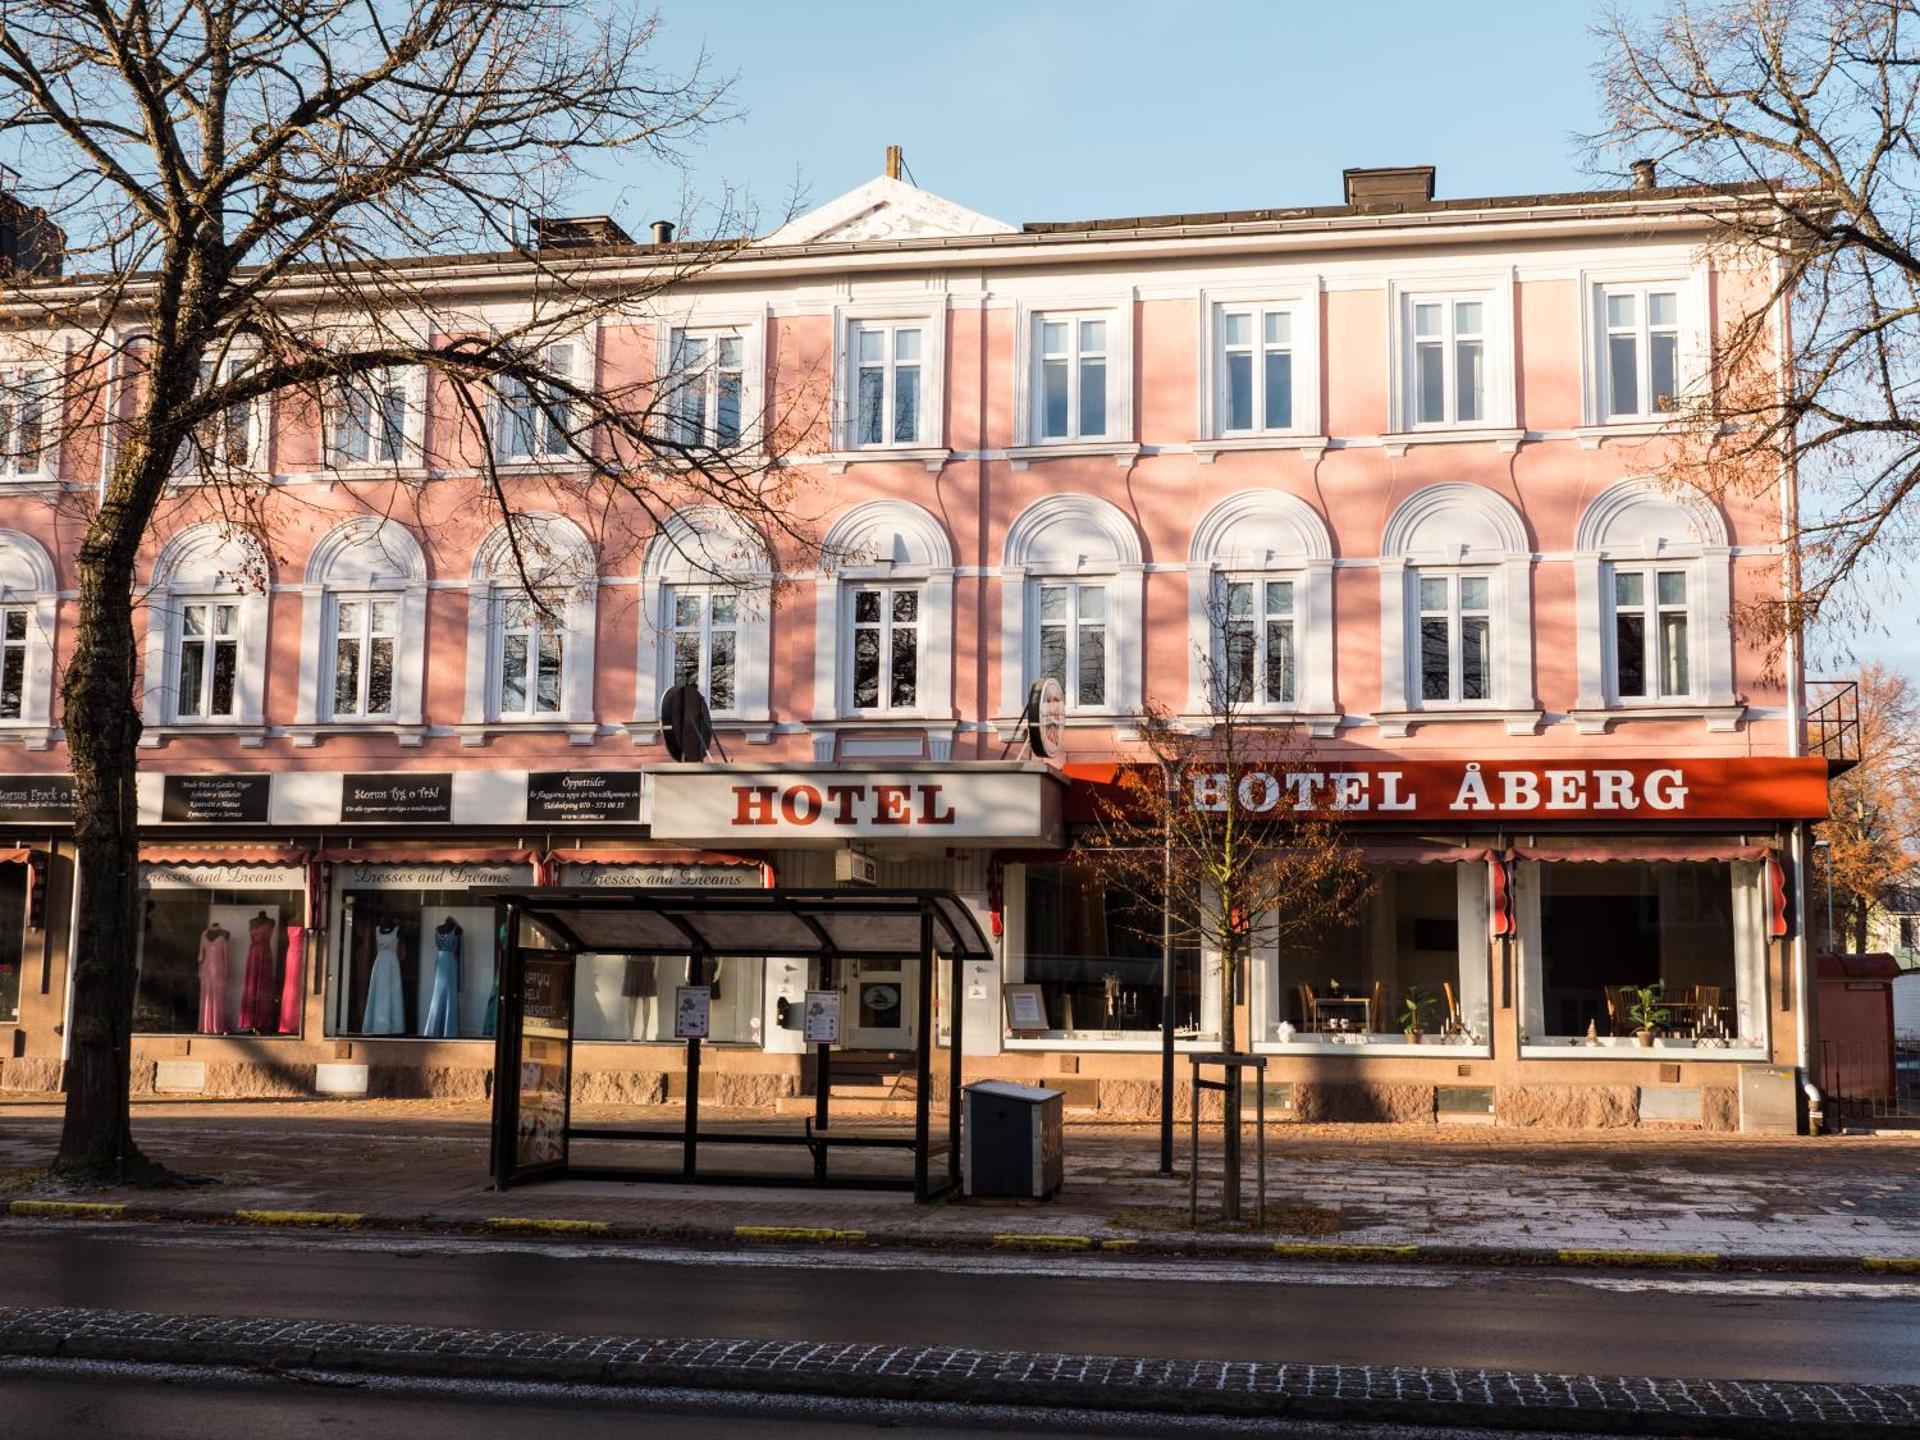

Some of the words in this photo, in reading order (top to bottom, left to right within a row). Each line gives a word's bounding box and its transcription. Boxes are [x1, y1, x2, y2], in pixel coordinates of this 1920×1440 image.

[562, 776, 606, 790] Öppettider
[1190, 771, 1417, 812] HOTEL
[1449, 762, 1689, 811] ÅBERG
[354, 789, 387, 800] Storms
[731, 784, 955, 826] HOTEL
[196, 867, 223, 883] and
[226, 867, 285, 883] Dreams
[354, 867, 413, 884] Dresses
[417, 867, 444, 883] and
[449, 866, 511, 883] Dreams
[580, 868, 641, 886] Dresses
[646, 869, 673, 886] and
[680, 868, 743, 886] Dreams
